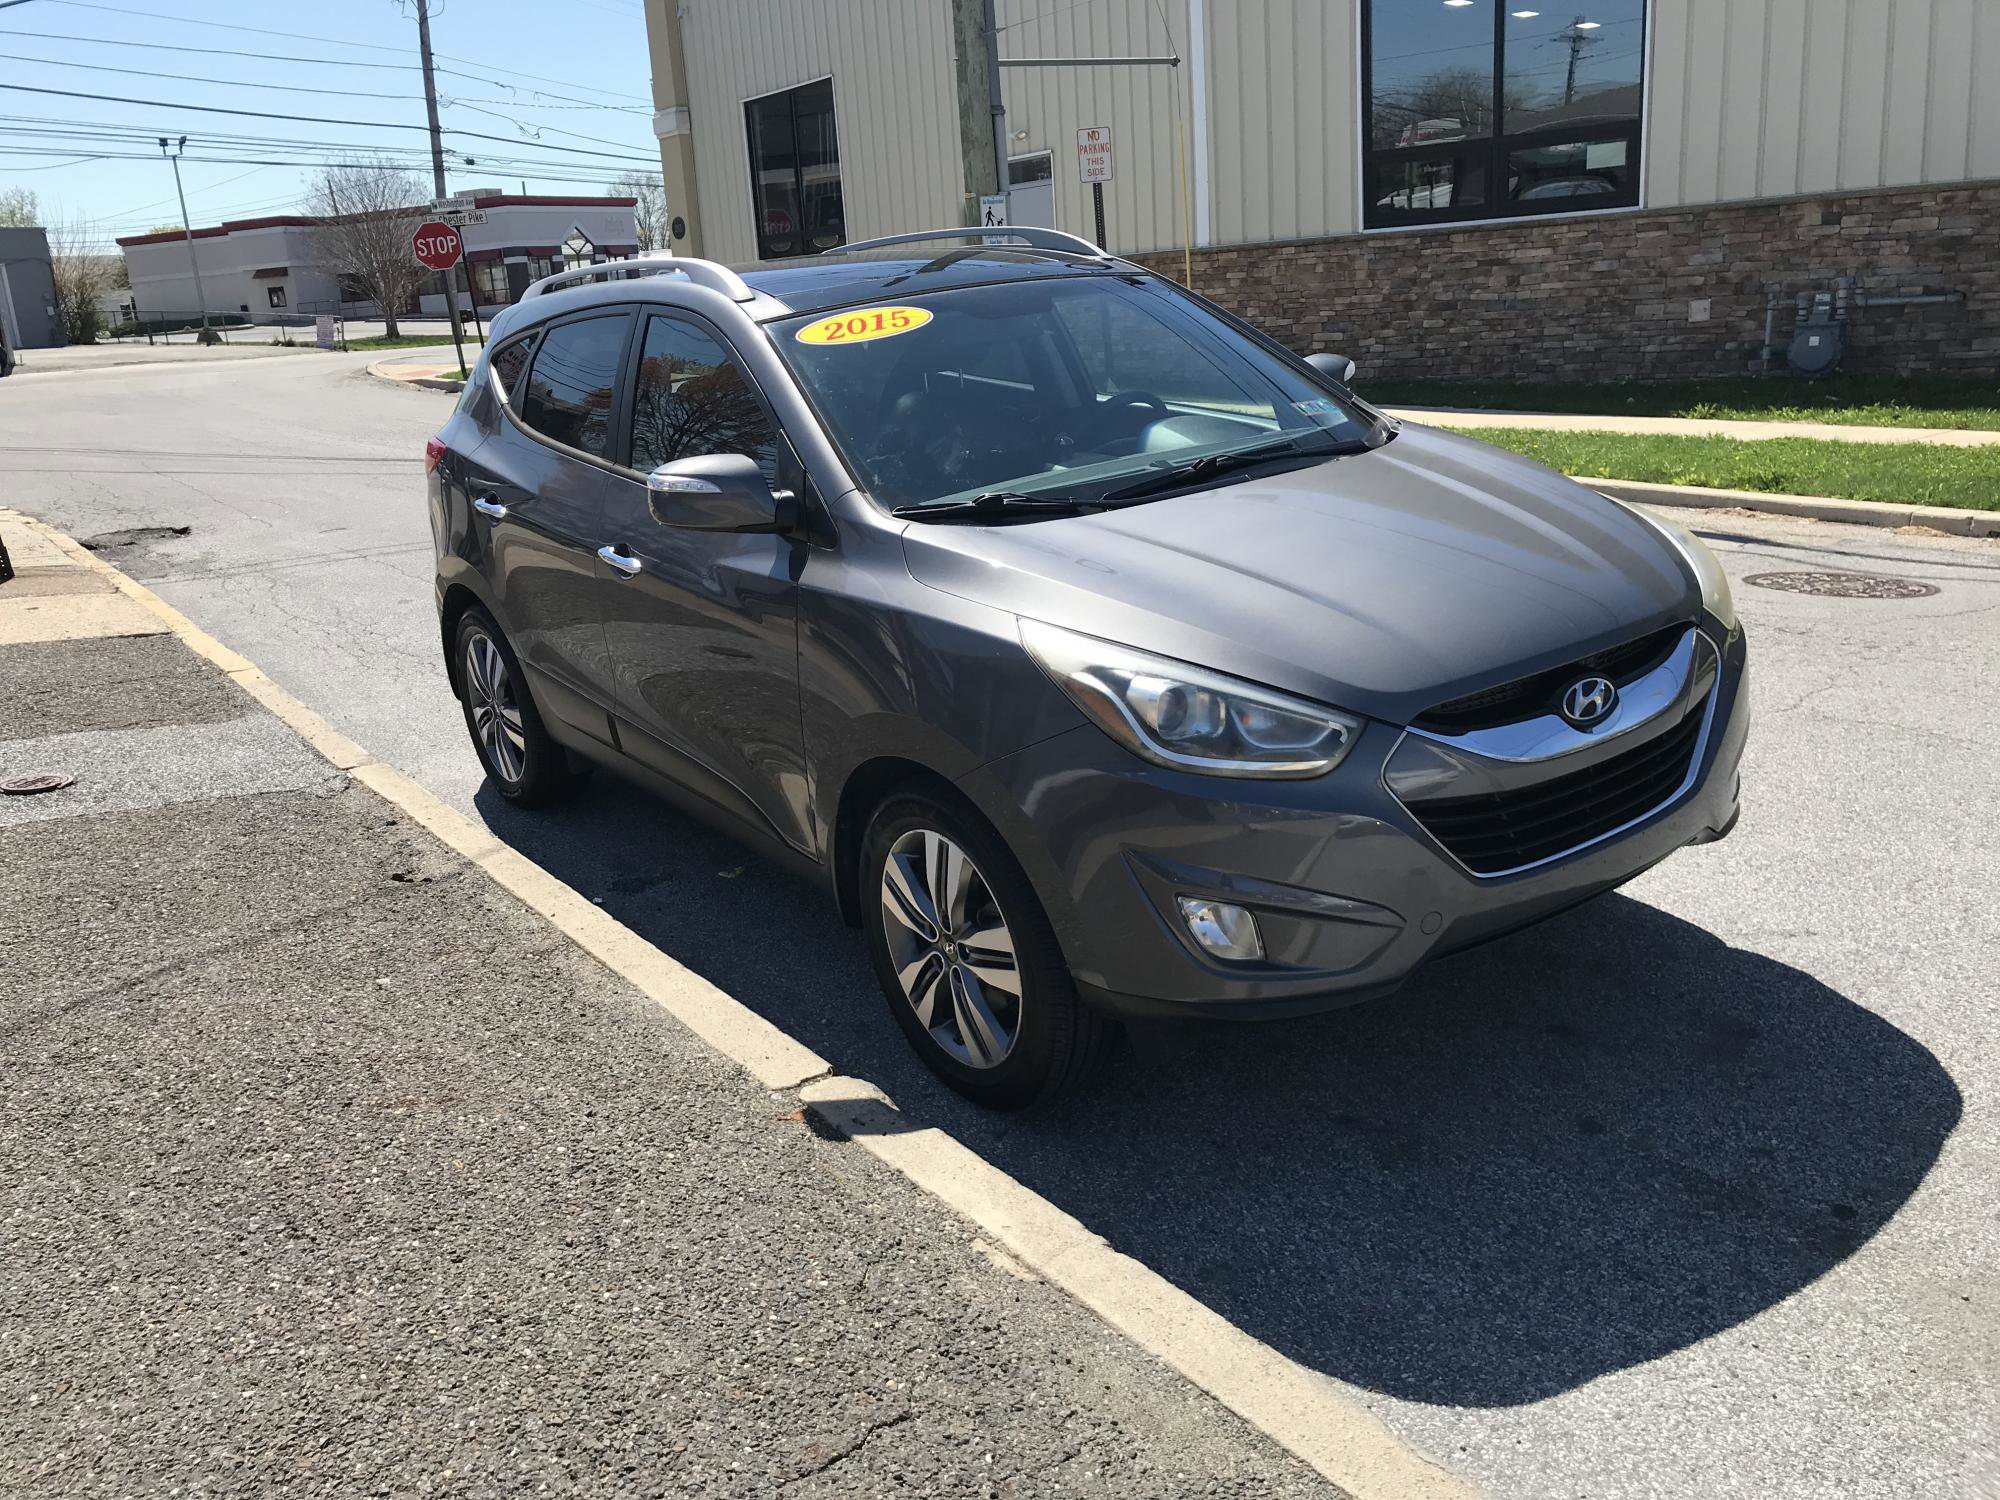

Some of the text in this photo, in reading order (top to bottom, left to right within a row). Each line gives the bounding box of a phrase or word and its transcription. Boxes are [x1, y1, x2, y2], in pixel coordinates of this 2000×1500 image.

[1087, 130, 1100, 141] NO
[1080, 143, 1110, 154] PARKING
[1087, 157, 1104, 166] THIS
[1088, 168, 1105, 176] SIDE
[468, 212, 484, 223] Pike
[417, 236, 457, 256] STOP
[824, 310, 910, 341] 2015
